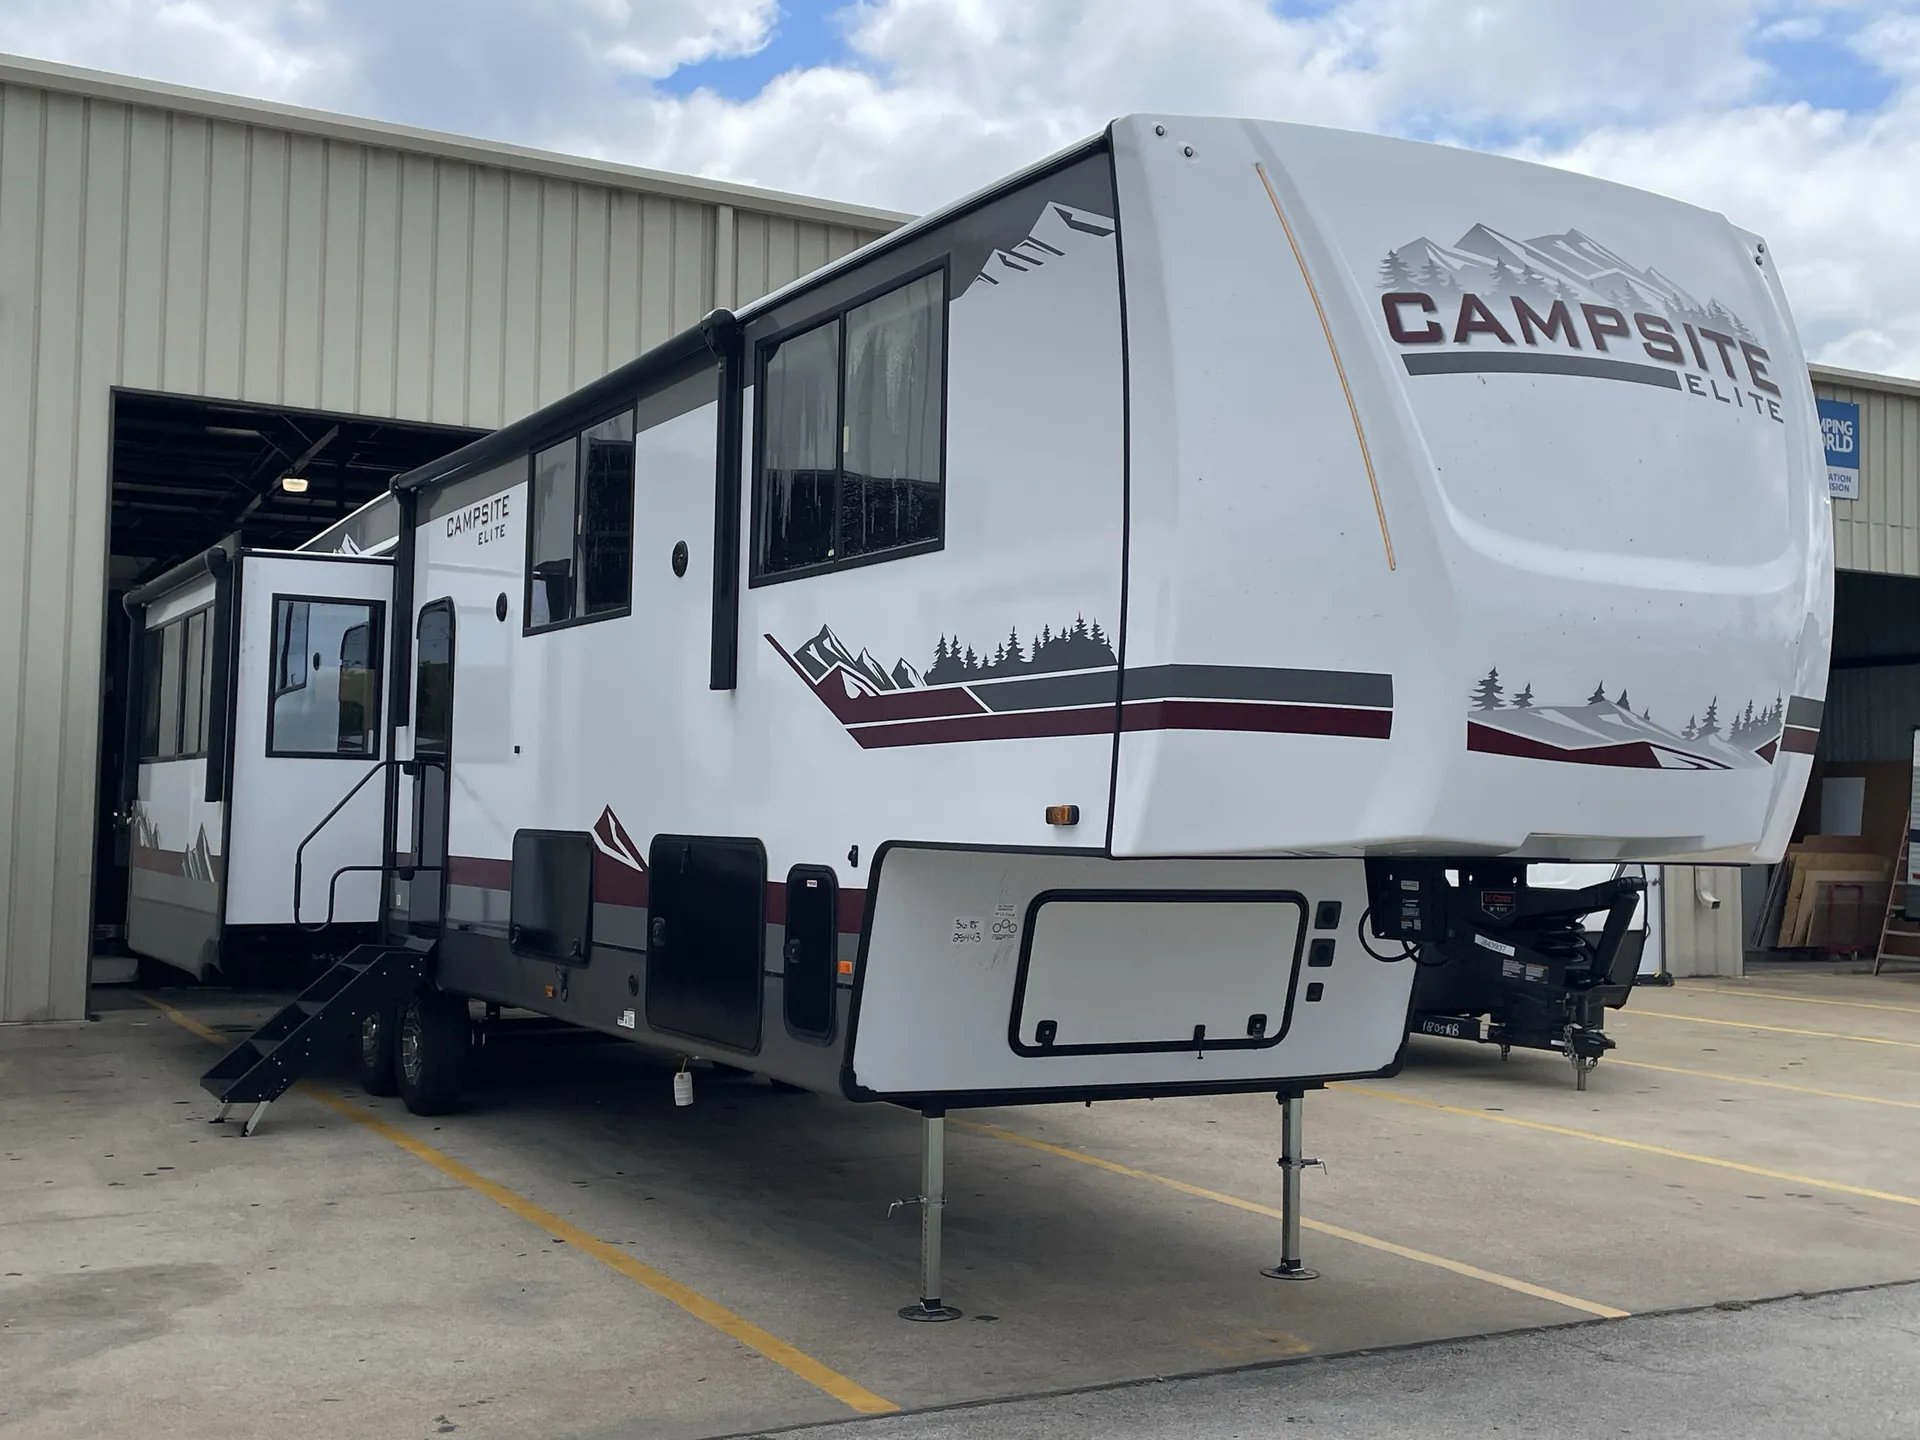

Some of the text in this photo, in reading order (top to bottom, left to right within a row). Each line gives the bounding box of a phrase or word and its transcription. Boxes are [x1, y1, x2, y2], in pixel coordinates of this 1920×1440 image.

[1381, 292, 1782, 398] CAMPSITE
[1685, 373, 1784, 424] ELITE
[446, 495, 510, 538] CAMPSITE
[478, 524, 506, 546] ELITE
